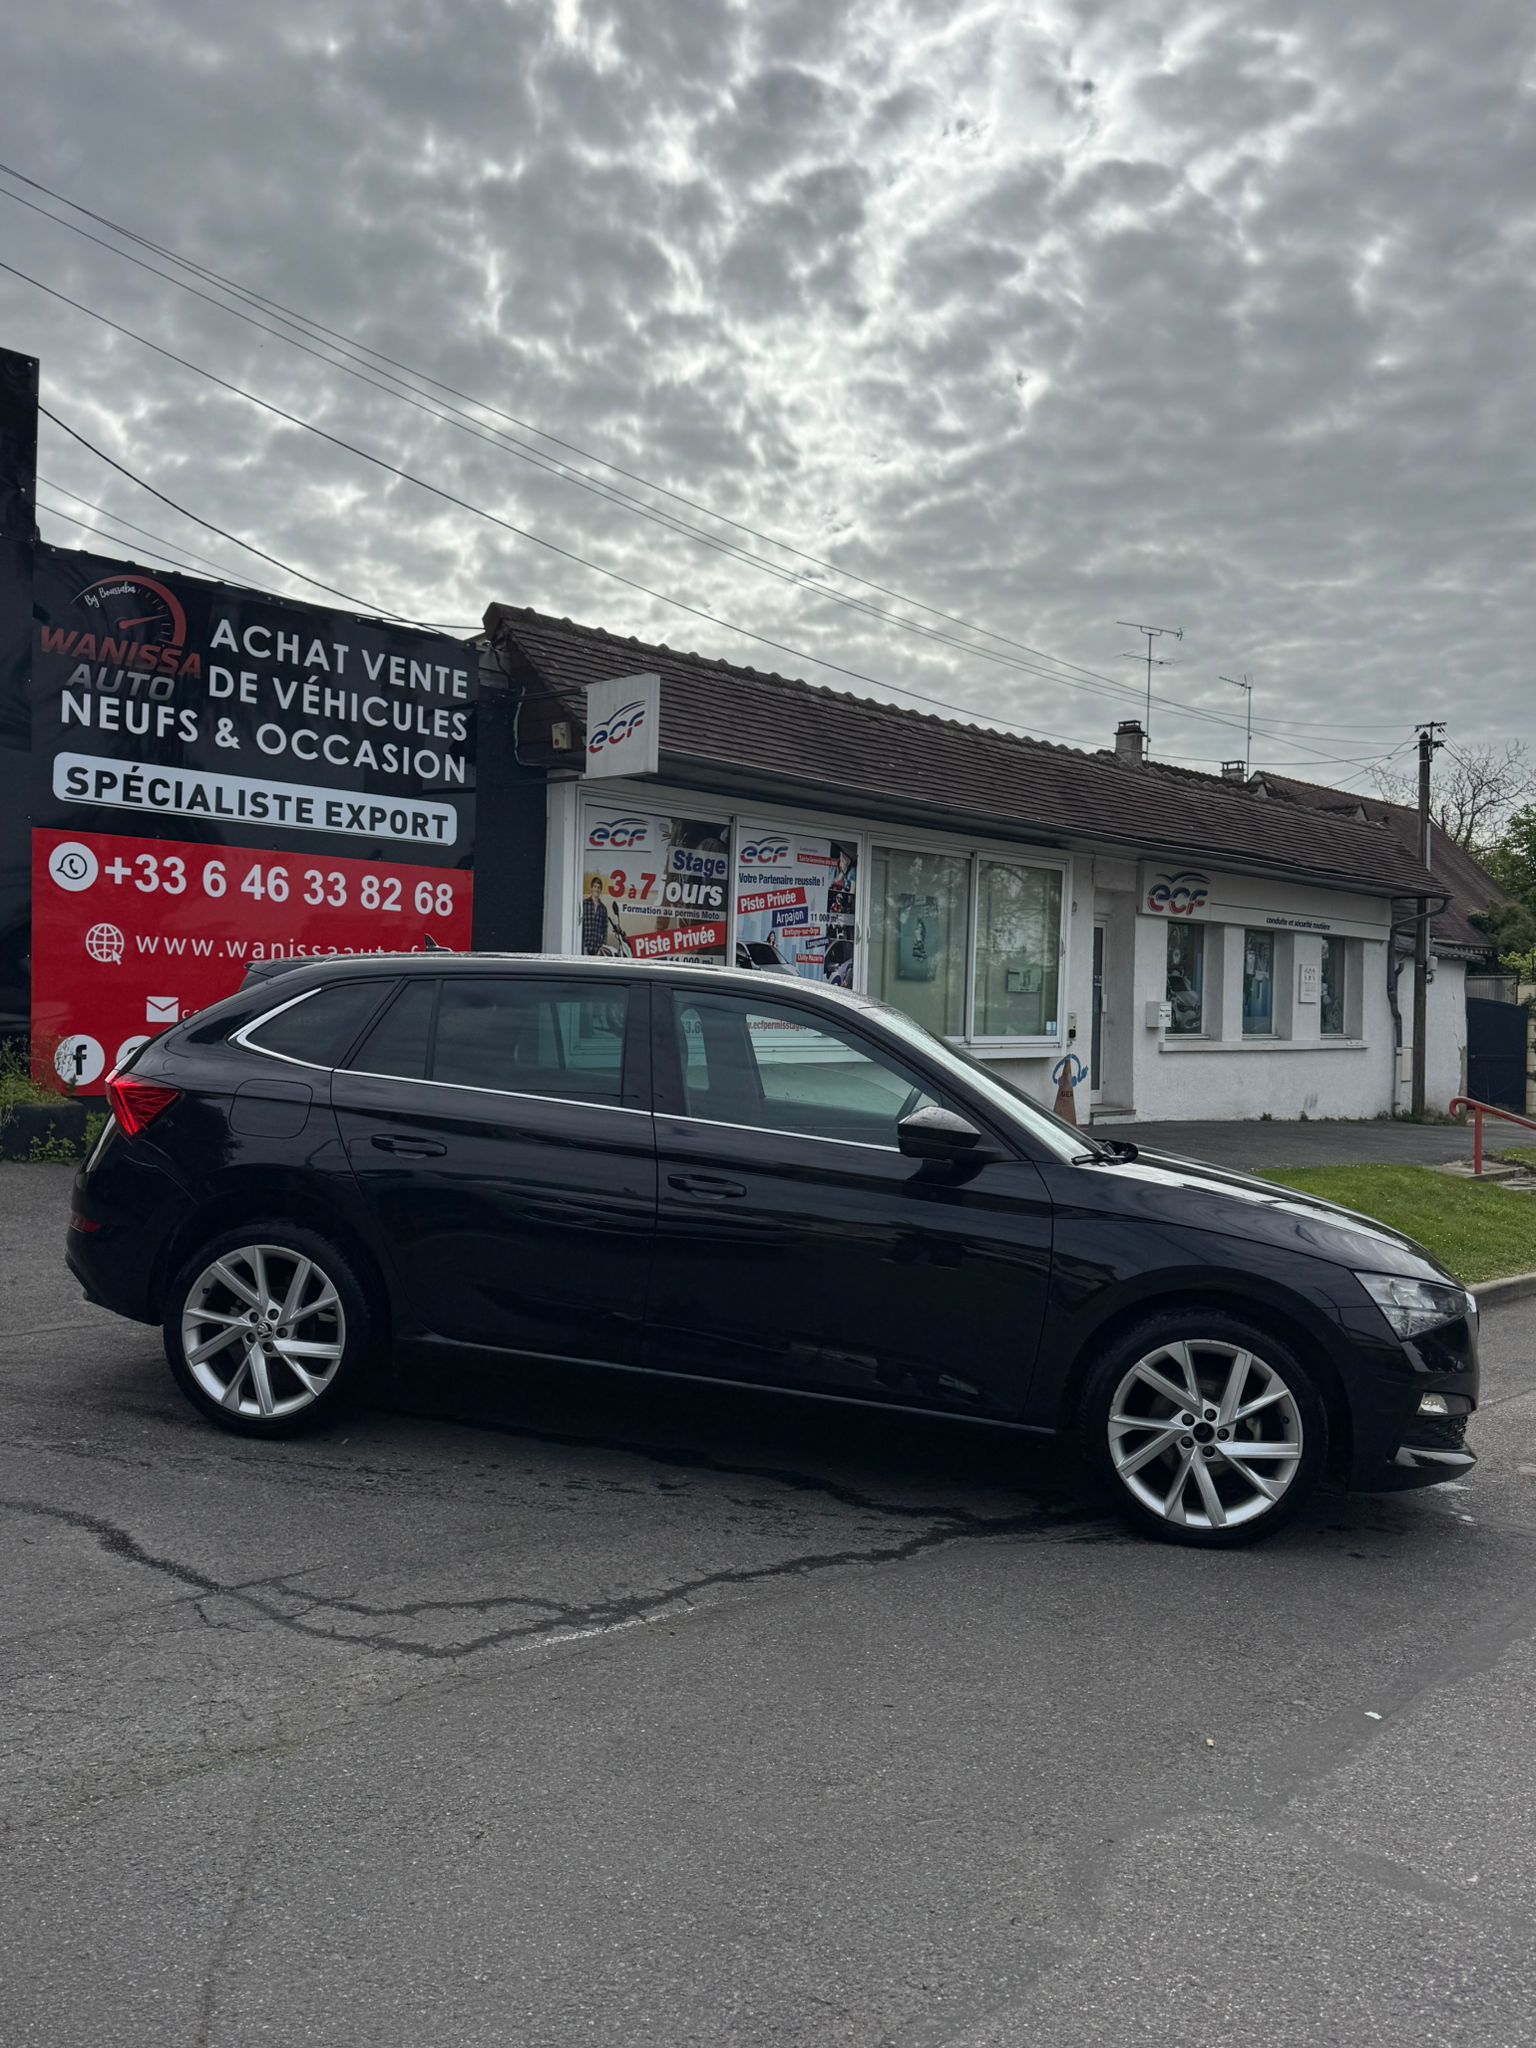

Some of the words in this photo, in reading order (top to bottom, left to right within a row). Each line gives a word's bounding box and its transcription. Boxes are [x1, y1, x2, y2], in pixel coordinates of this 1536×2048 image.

[84, 595, 100, 608] By
[41, 625, 202, 679] WANISSA
[210, 618, 349, 674] ACHAT
[362, 648, 468, 699] VENTE
[65, 663, 175, 701] AUTO
[210, 665, 258, 704] DE
[272, 675, 468, 742] VÉHICULES
[61, 690, 199, 743] NEUFS
[214, 718, 240, 750] &
[256, 724, 466, 784] OCCASION
[64, 765, 314, 824] SPÉCIALISTE
[325, 800, 449, 839] EXPORT
[673, 850, 726, 878] Stage
[738, 872, 758, 884] Votre
[758, 874, 794, 886] Partenaire
[104, 854, 186, 894] +33
[203, 860, 227, 898] 6
[240, 864, 290, 903] 46
[304, 869, 347, 908] 33
[360, 875, 402, 912] 82
[414, 881, 454, 917] 68
[608, 869, 626, 898] 3
[628, 884, 637, 899] à
[640, 873, 656, 900] 7
[654, 875, 723, 906] jours
[740, 895, 764, 912] Piste
[767, 890, 796, 906] Privée
[622, 904, 662, 916] Formation
[674, 910, 700, 918] permis
[702, 911, 720, 920] Moto
[776, 910, 804, 926] Arpajon
[1266, 917, 1288, 926] conduite
[1294, 920, 1312, 928] sécurité
[1312, 922, 1330, 930] routière
[635, 936, 670, 956] Piste
[673, 927, 716, 949] Privée
